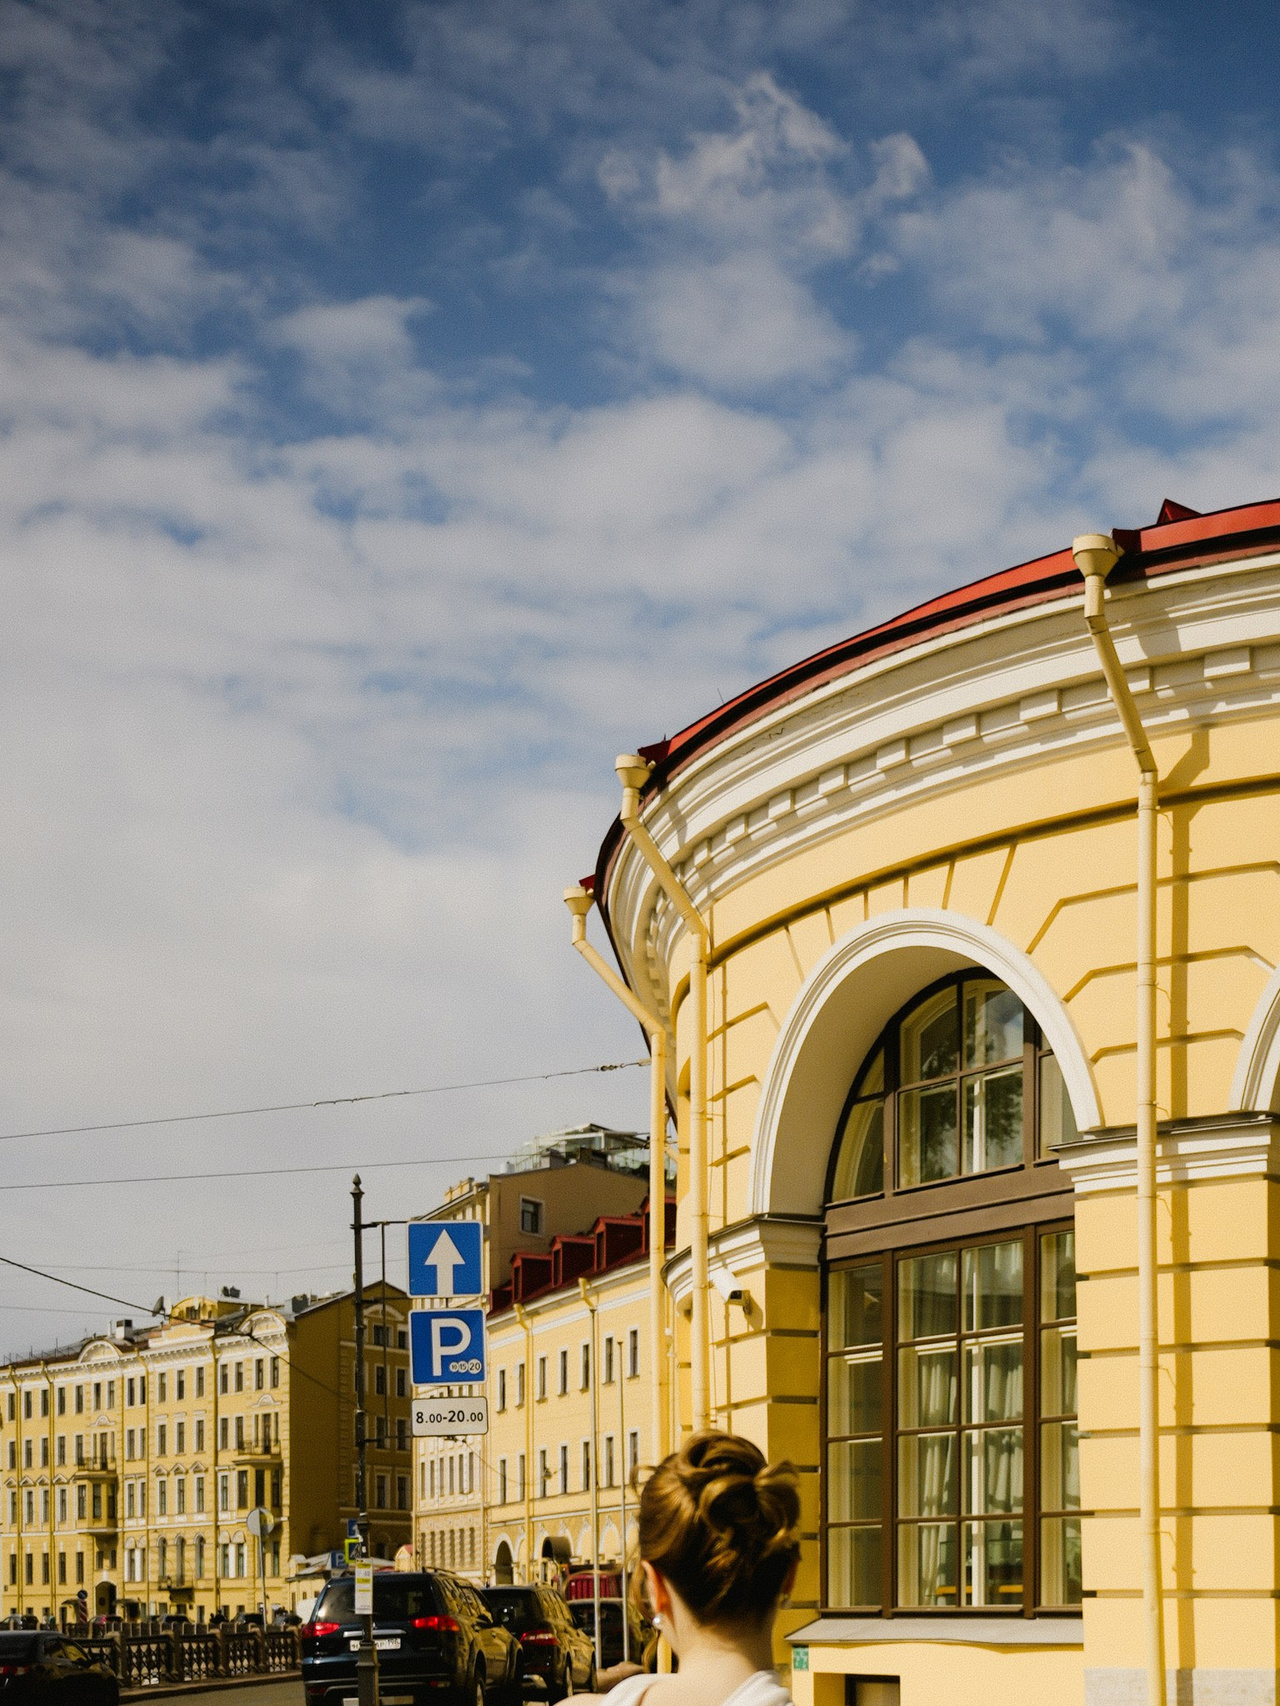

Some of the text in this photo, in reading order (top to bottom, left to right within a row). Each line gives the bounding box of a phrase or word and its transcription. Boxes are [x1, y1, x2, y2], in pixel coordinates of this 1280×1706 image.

[431, 1318, 472, 1377] P
[469, 1362, 481, 1371] 20
[416, 1410, 484, 1424] 8.00-20.00
